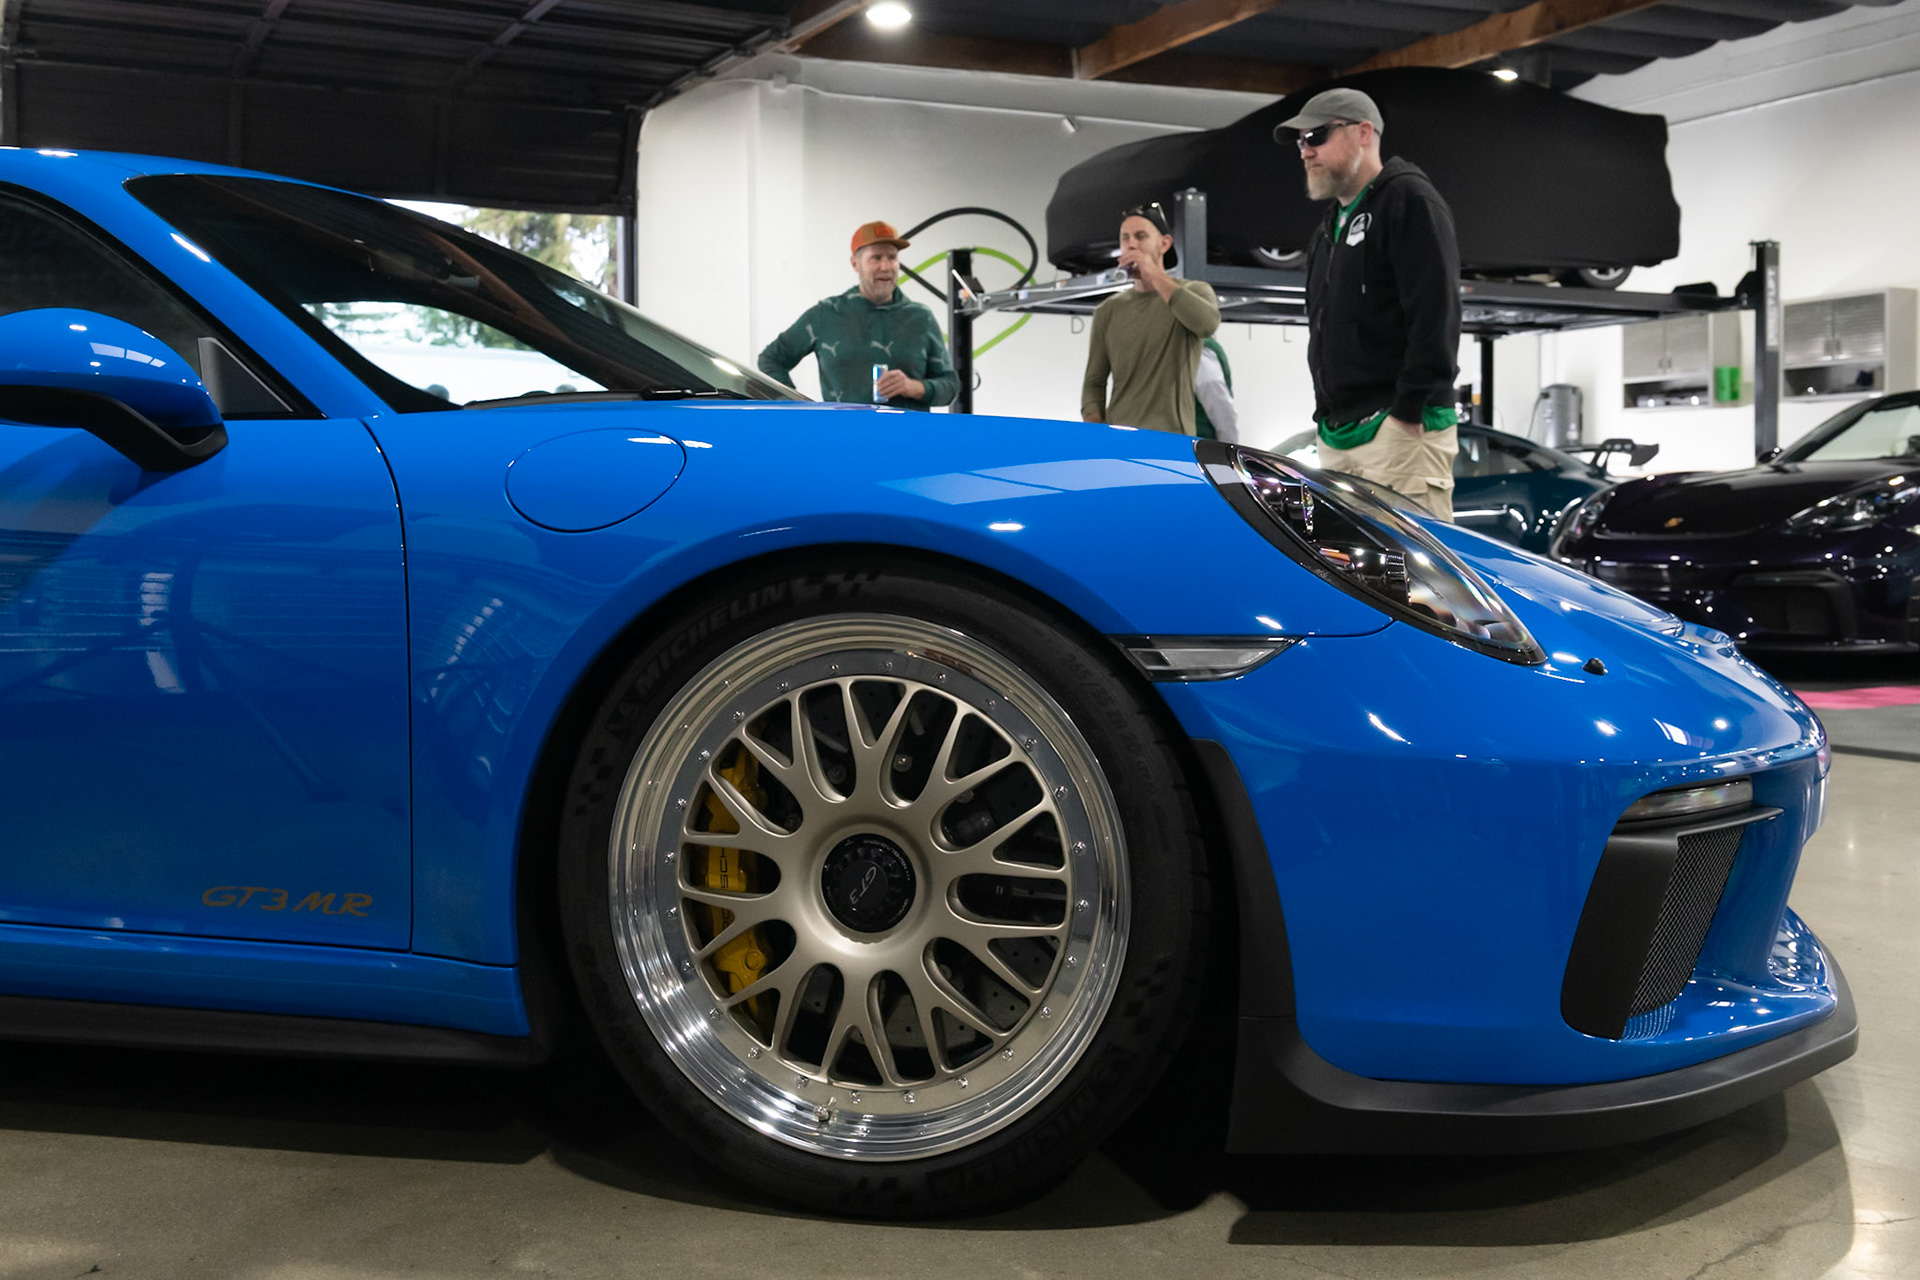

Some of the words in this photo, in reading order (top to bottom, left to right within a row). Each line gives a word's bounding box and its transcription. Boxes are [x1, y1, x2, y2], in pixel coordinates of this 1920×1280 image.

[634, 580, 789, 698] MICHELIN
[201, 885, 290, 911] GT3
[292, 890, 373, 917] MR
[849, 866, 877, 904] GT3
